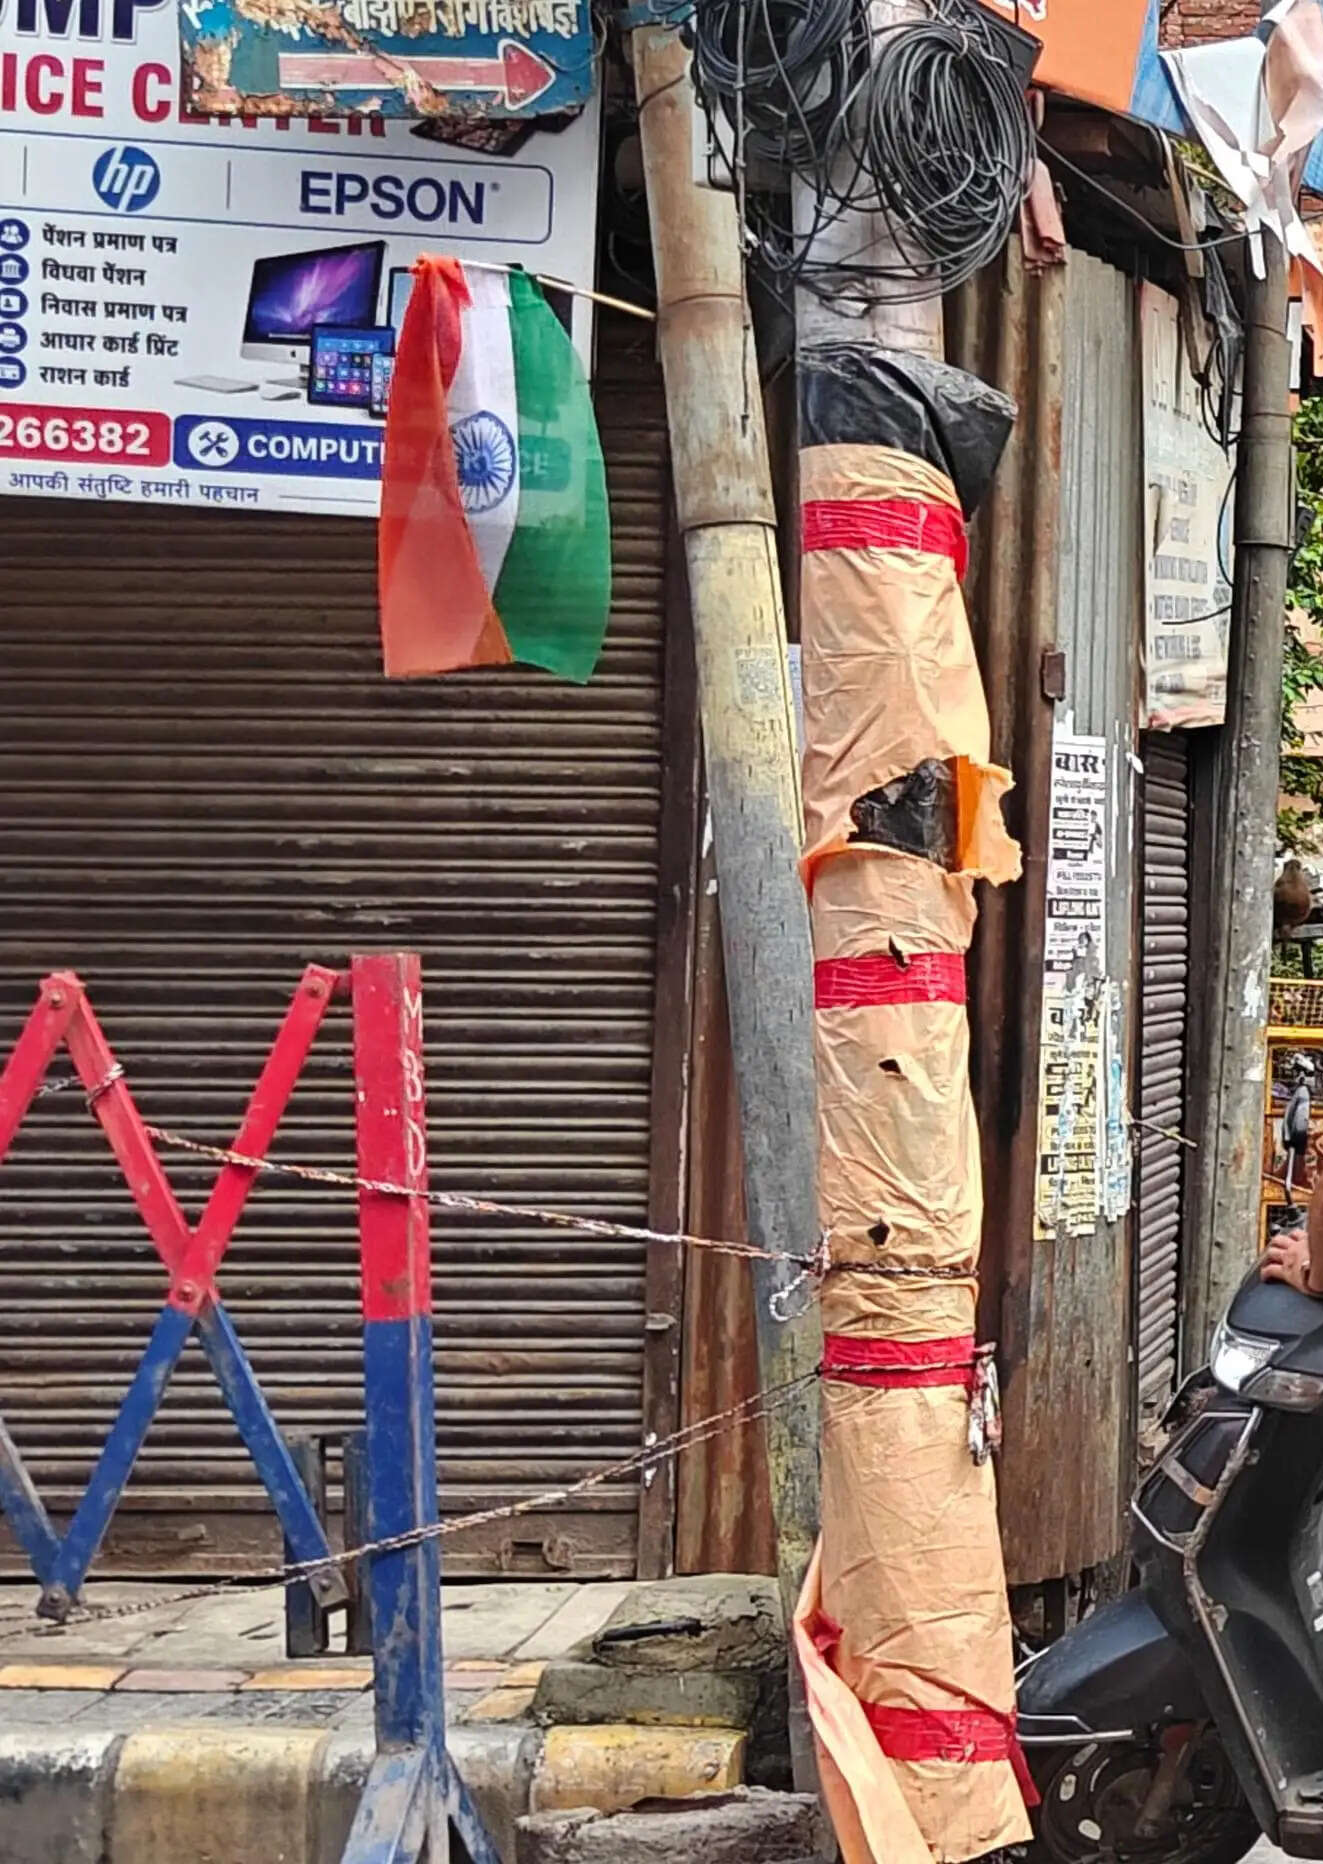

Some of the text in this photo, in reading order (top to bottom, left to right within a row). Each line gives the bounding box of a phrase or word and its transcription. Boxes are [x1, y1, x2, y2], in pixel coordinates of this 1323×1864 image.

[100, 148, 154, 211] hp
[300, 170, 485, 224] EPSON
[247, 433, 385, 465] COMPUT
